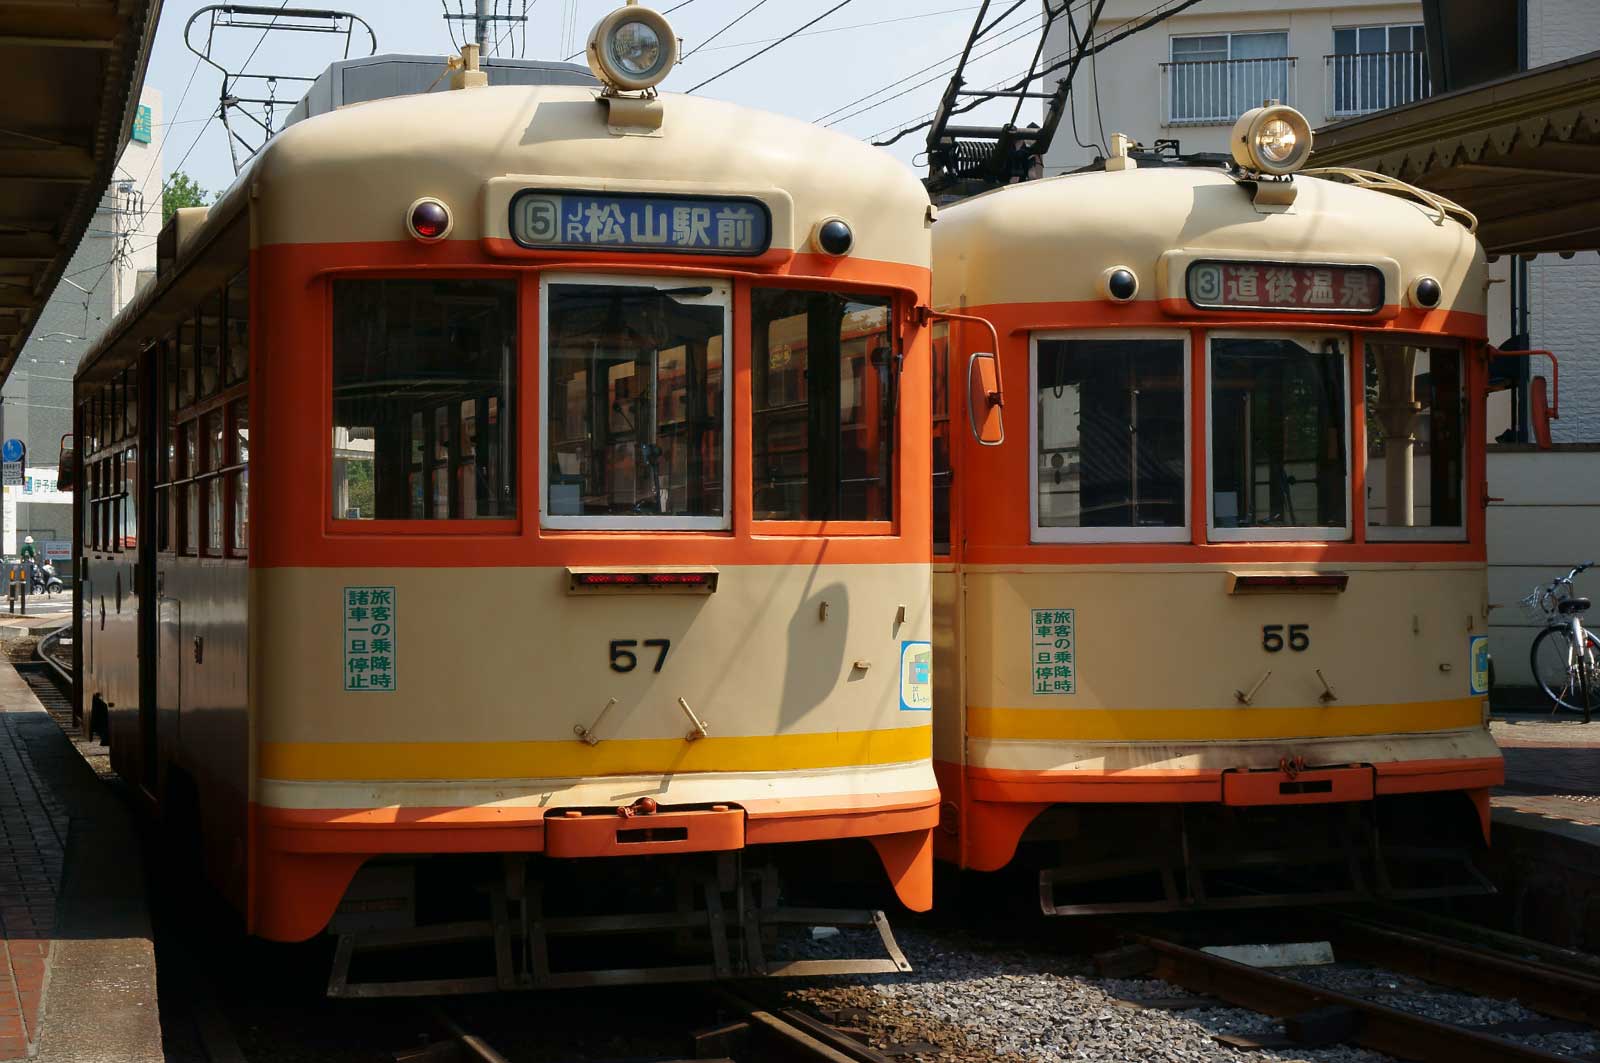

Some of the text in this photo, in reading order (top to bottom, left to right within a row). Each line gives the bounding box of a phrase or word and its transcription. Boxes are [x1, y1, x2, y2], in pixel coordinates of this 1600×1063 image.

[531, 206, 551, 235] 5
[1200, 267, 1371, 305] 3 道後温泉
[348, 590, 369, 689] 諸車一旦停止
[370, 589, 392, 688] 旅客の乗降時
[609, 639, 671, 673] 57
[1035, 612, 1053, 693] 諸車一旦停止
[1054, 611, 1072, 692] 旅客の乗降時
[1263, 623, 1310, 652] 55
